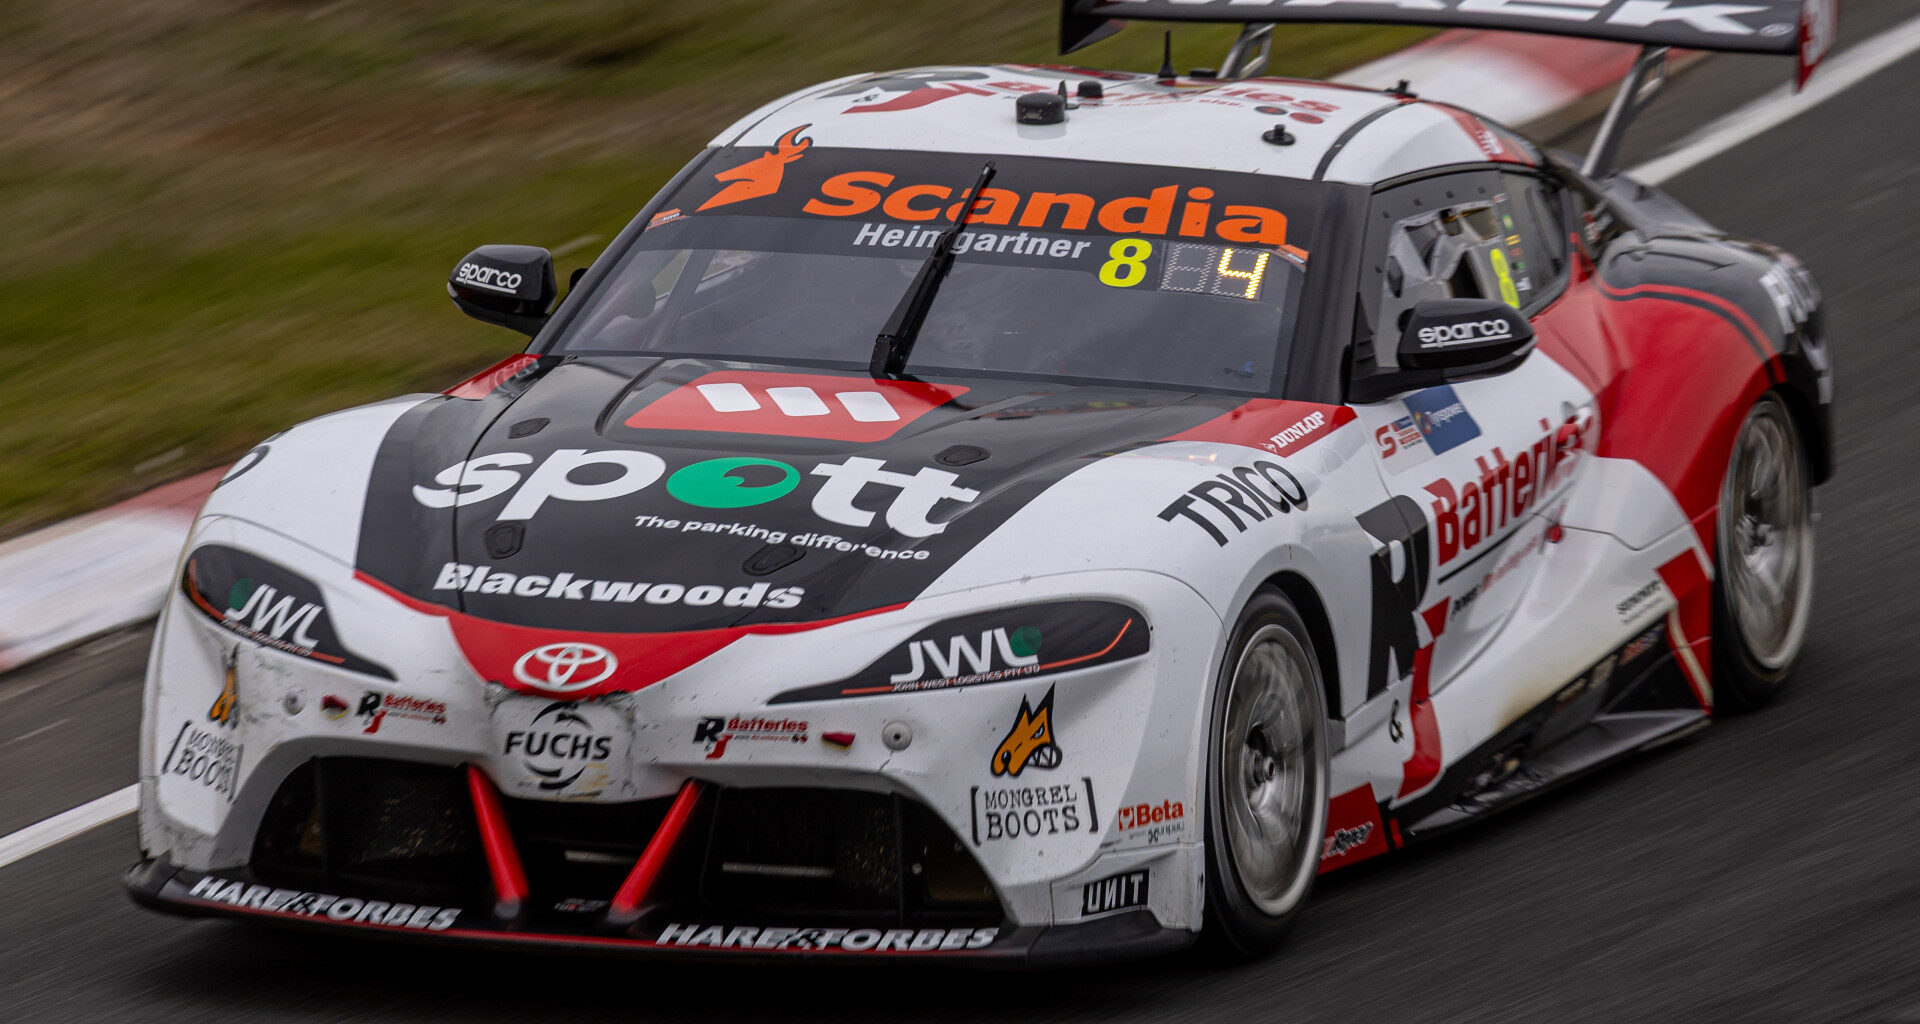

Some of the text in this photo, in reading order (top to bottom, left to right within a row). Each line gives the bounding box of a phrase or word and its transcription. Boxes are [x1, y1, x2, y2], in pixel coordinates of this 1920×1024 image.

[802, 171, 1289, 245] Scandia
[853, 222, 1092, 259] Heimgartner
[458, 262, 522, 289] sparco
[1099, 238, 1152, 288] 8
[1218, 247, 1270, 299] 4
[1418, 318, 1510, 348] sparco
[1269, 410, 1325, 449] DUNLOP
[412, 448, 981, 538] spott
[1156, 460, 1309, 548] TRICO
[634, 515, 931, 561] The parking difference
[432, 562, 806, 610] Blackwoods
[224, 583, 324, 648] JWL
[890, 626, 1039, 685] JWL
[726, 716, 810, 732] Batteries
[503, 730, 614, 761] FUCHS
[984, 784, 1078, 810] MONGREL
[1136, 798, 1184, 828] Beta
[985, 803, 1080, 841] BOOTS
